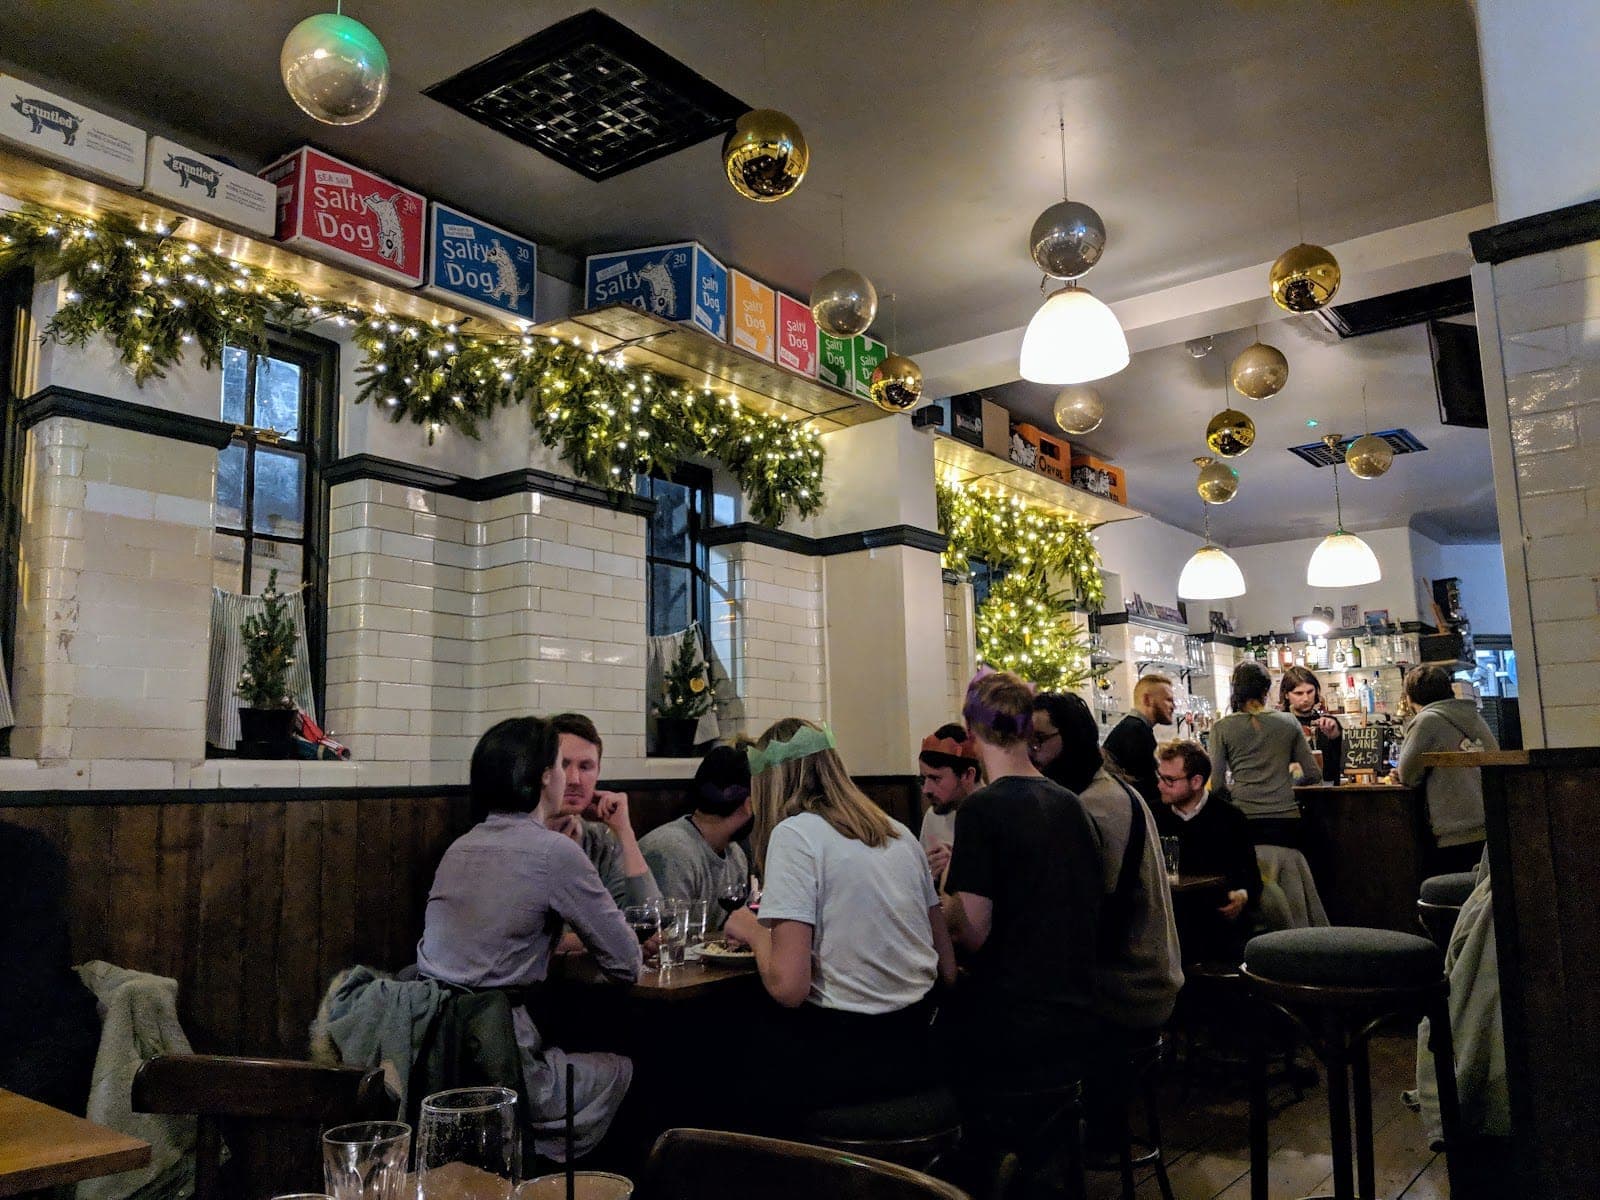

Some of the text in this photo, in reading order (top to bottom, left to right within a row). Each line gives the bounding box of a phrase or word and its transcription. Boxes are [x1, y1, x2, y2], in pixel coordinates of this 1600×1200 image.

[22, 102, 72, 128] gruntled
[172, 160, 214, 182] gruntled
[313, 186, 368, 215] Salty
[317, 212, 374, 248] Dog
[442, 240, 488, 263] Salty
[516, 246, 529, 259] 30
[673, 253, 687, 265] 30
[446, 262, 494, 293] Dog
[702, 277, 718, 293] Salty
[595, 272, 642, 301] Salty
[703, 292, 720, 312] Dog
[744, 313, 766, 332] Dog
[787, 320, 806, 333] Salty
[788, 334, 808, 351] Dog
[825, 339, 843, 352] Salty
[826, 352, 845, 368] Dog
[860, 355, 877, 366] Salty
[1343, 728, 1378, 740] MULLED
[1349, 740, 1378, 749] WINE
[1345, 751, 1379, 768] £4.50
